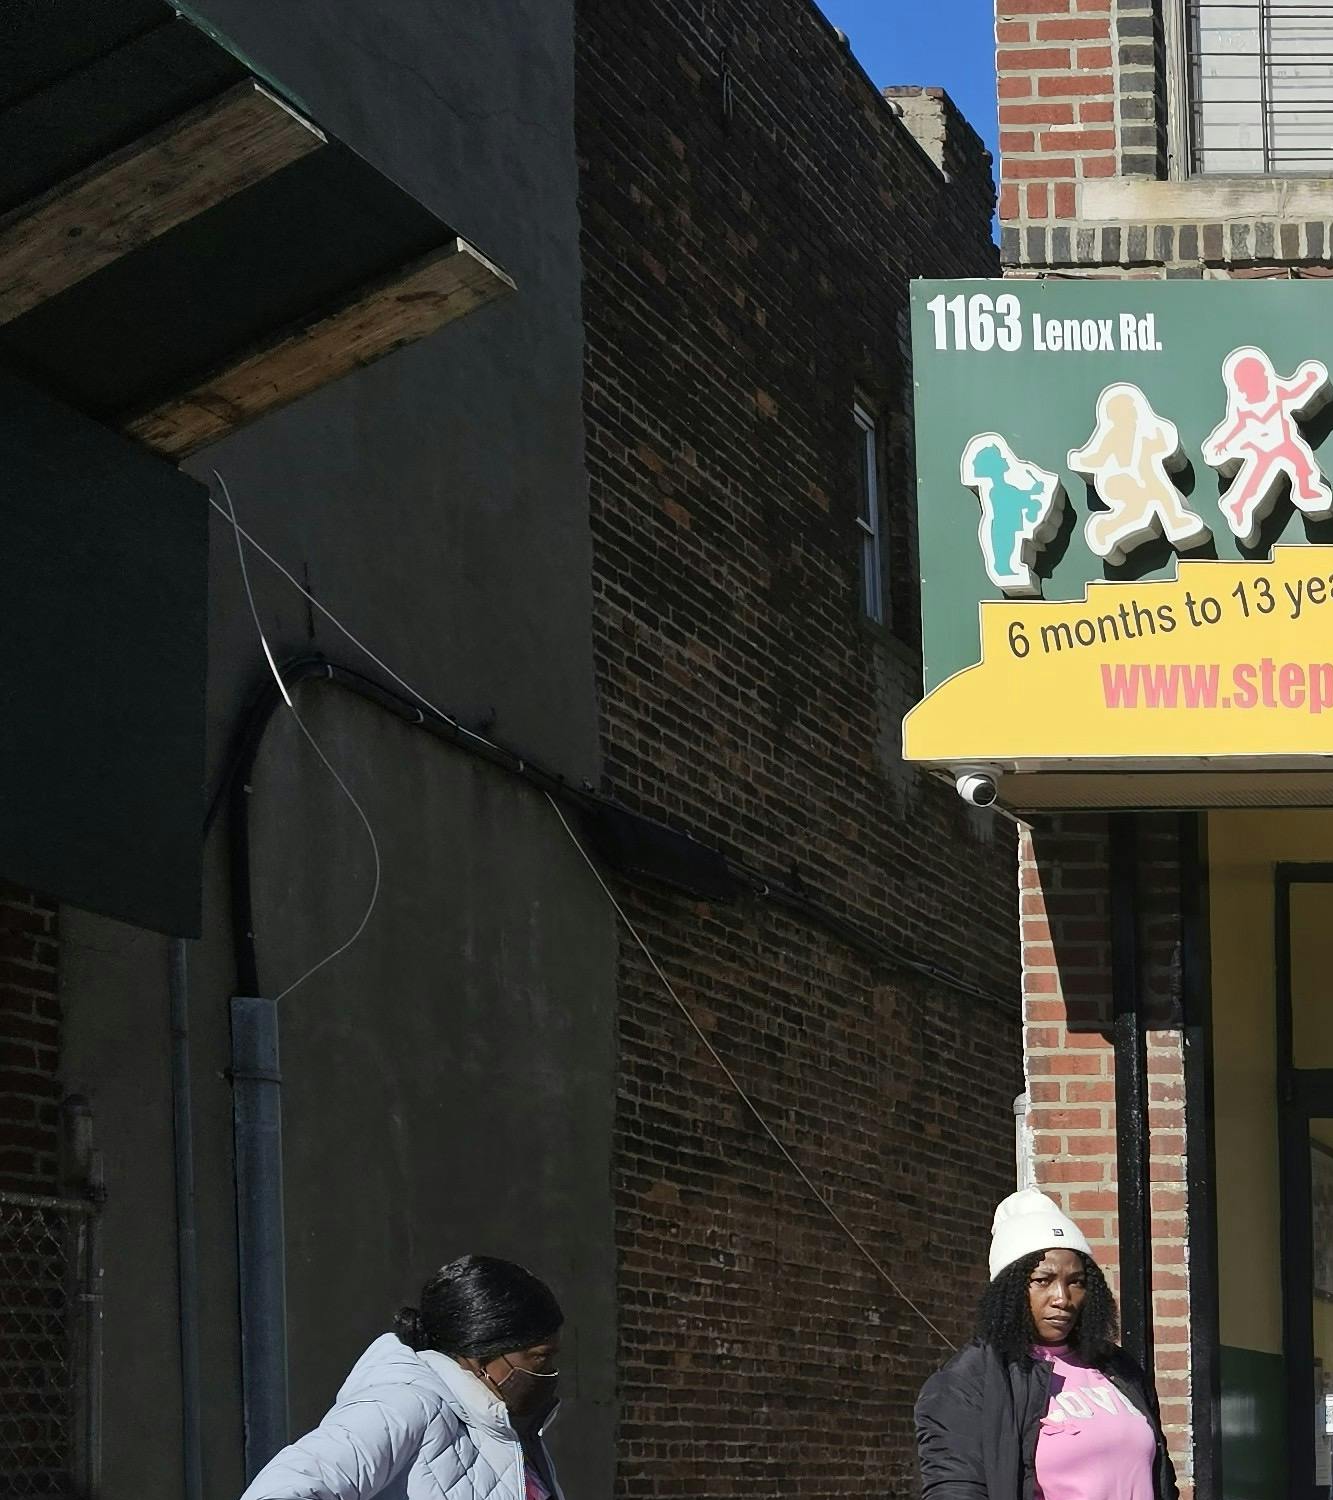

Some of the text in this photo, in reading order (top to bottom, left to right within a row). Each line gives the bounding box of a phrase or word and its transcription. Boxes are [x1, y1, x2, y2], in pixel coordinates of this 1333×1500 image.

[927, 294, 1163, 352] 1163 Lenox Rd.
[1007, 620, 1031, 660] 6
[1041, 599, 1177, 654] months
[1184, 586, 1223, 628] to
[1231, 576, 1277, 618] 13
